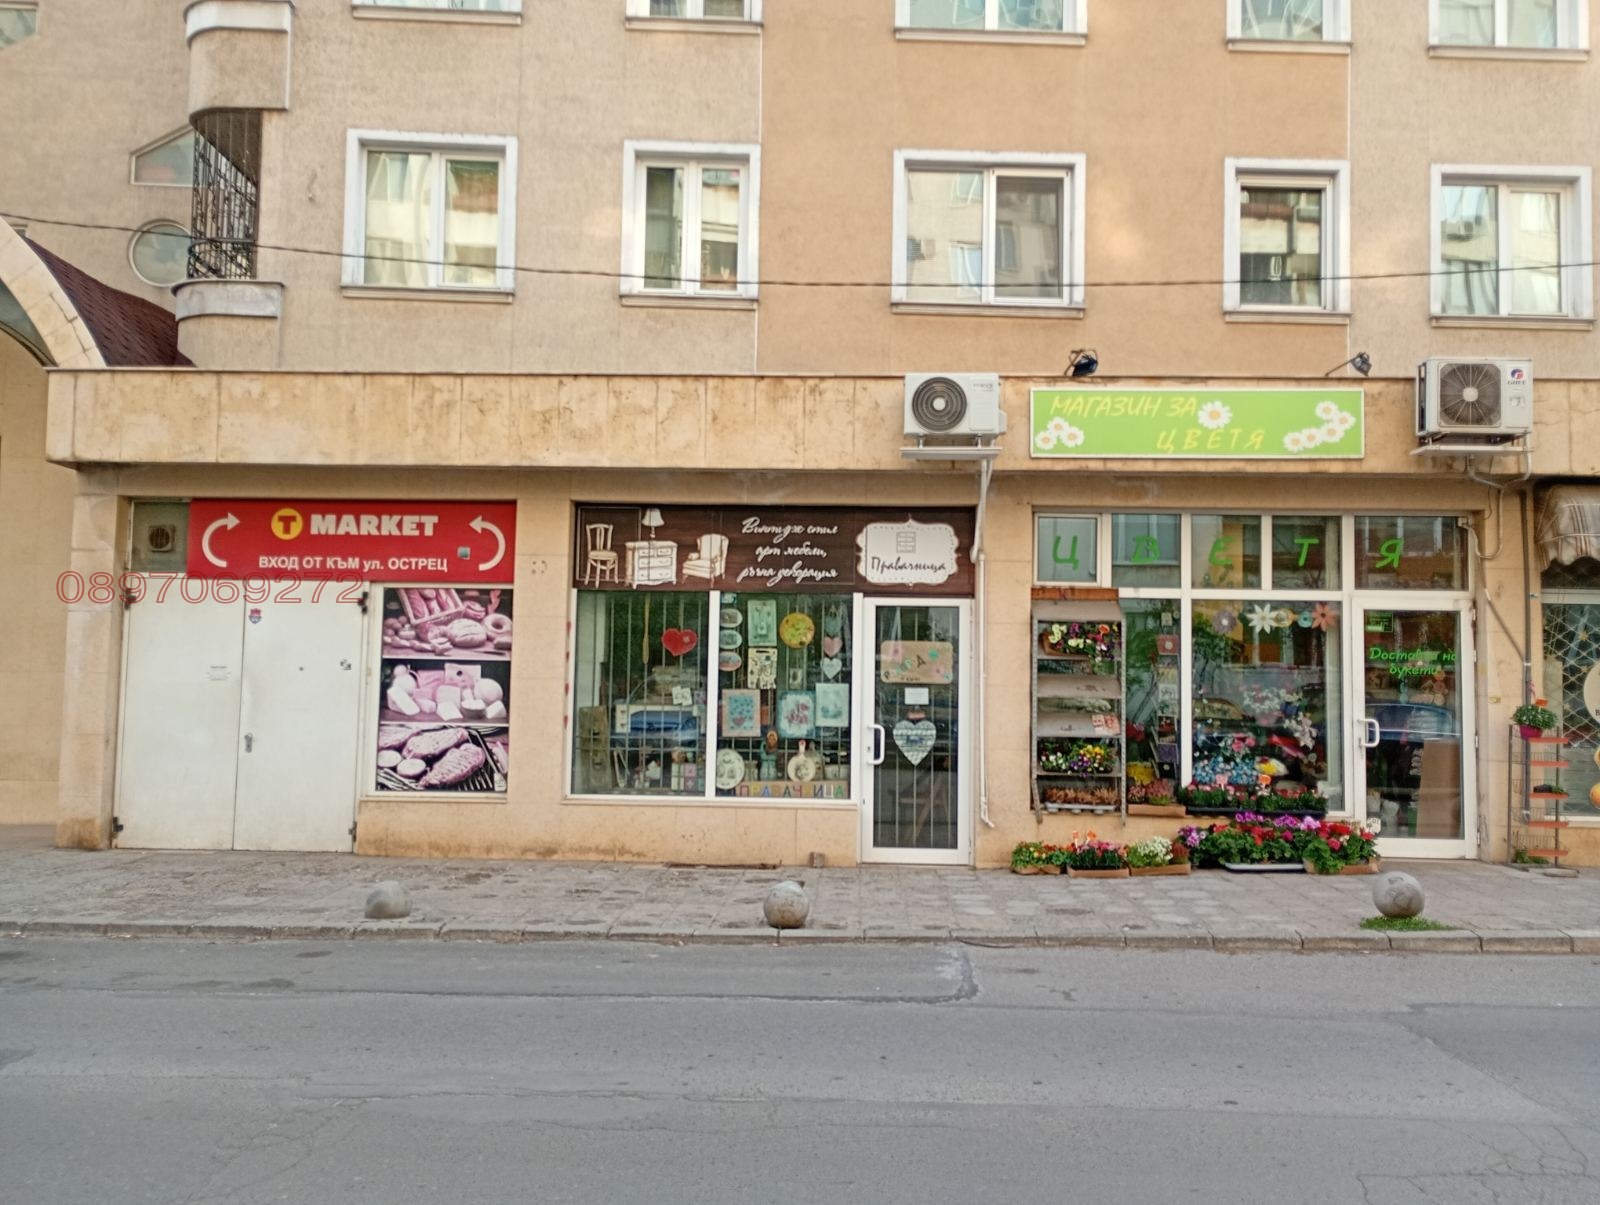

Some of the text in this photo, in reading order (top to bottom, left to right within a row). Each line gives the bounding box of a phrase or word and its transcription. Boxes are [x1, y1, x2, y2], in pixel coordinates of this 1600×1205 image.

[1050, 396, 1198, 417] МАГАЗИН ЗА
[1156, 429, 1266, 453] ЦВЕТЯ
[309, 514, 439, 537] MARKET
[258, 556, 448, 573] ВХОД ОТ КЪМ ул. ОСТРЕЦ
